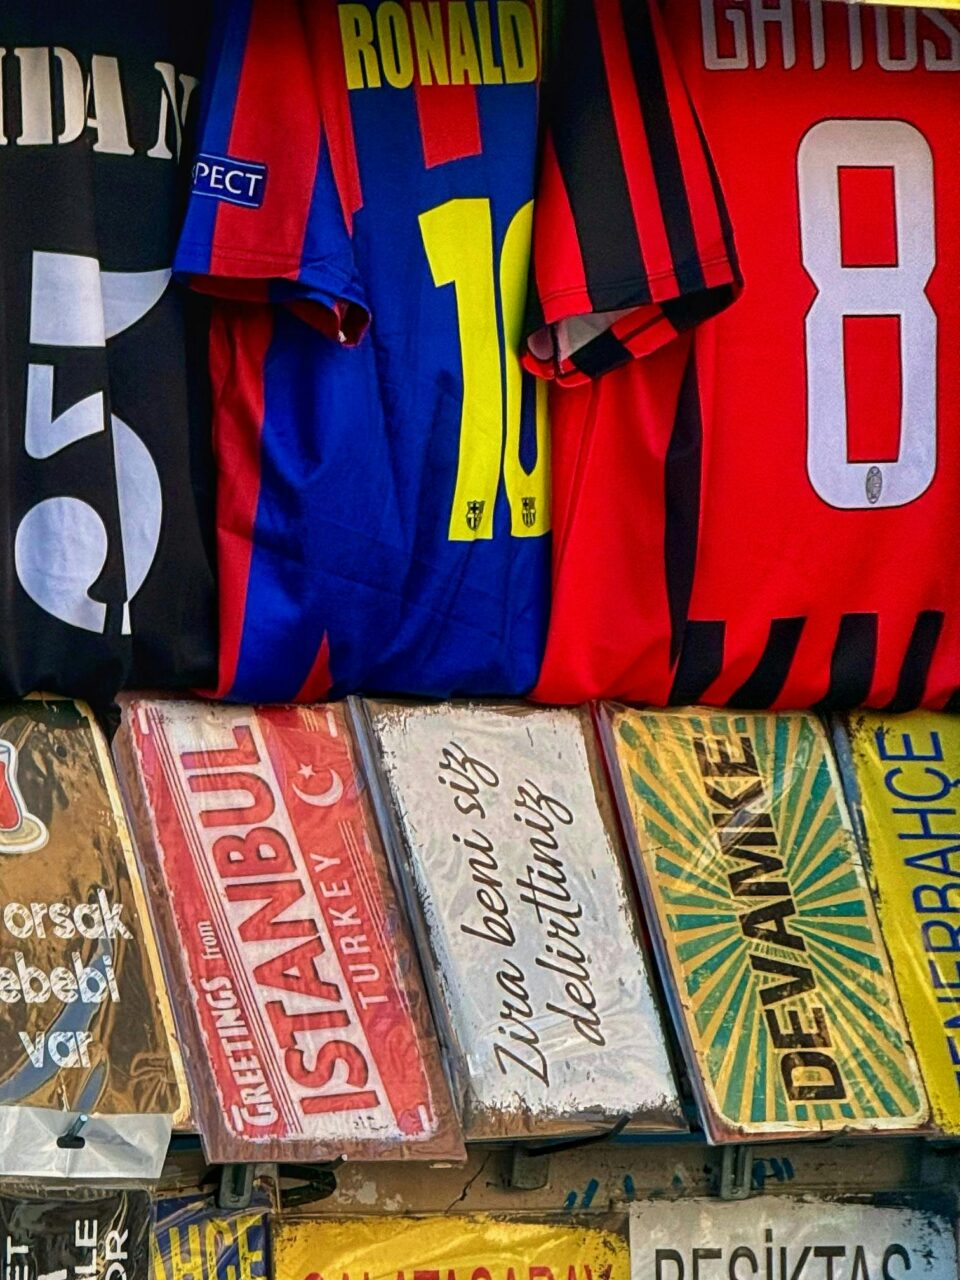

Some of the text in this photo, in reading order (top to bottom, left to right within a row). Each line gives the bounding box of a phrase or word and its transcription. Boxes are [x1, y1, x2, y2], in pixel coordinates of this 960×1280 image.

[193, 162, 263, 197] PECT
[796, 118, 938, 509] 8
[15, 250, 173, 635] 5
[437, 740, 500, 820] siz
[180, 723, 382, 1116] ISTANBUL
[310, 852, 387, 1011] TURKEY
[460, 828, 517, 948] beni
[692, 733, 847, 1102] DEVAMKE
[18, 1030, 95, 1069] var
[195, 920, 279, 1128] GREETINGS from
